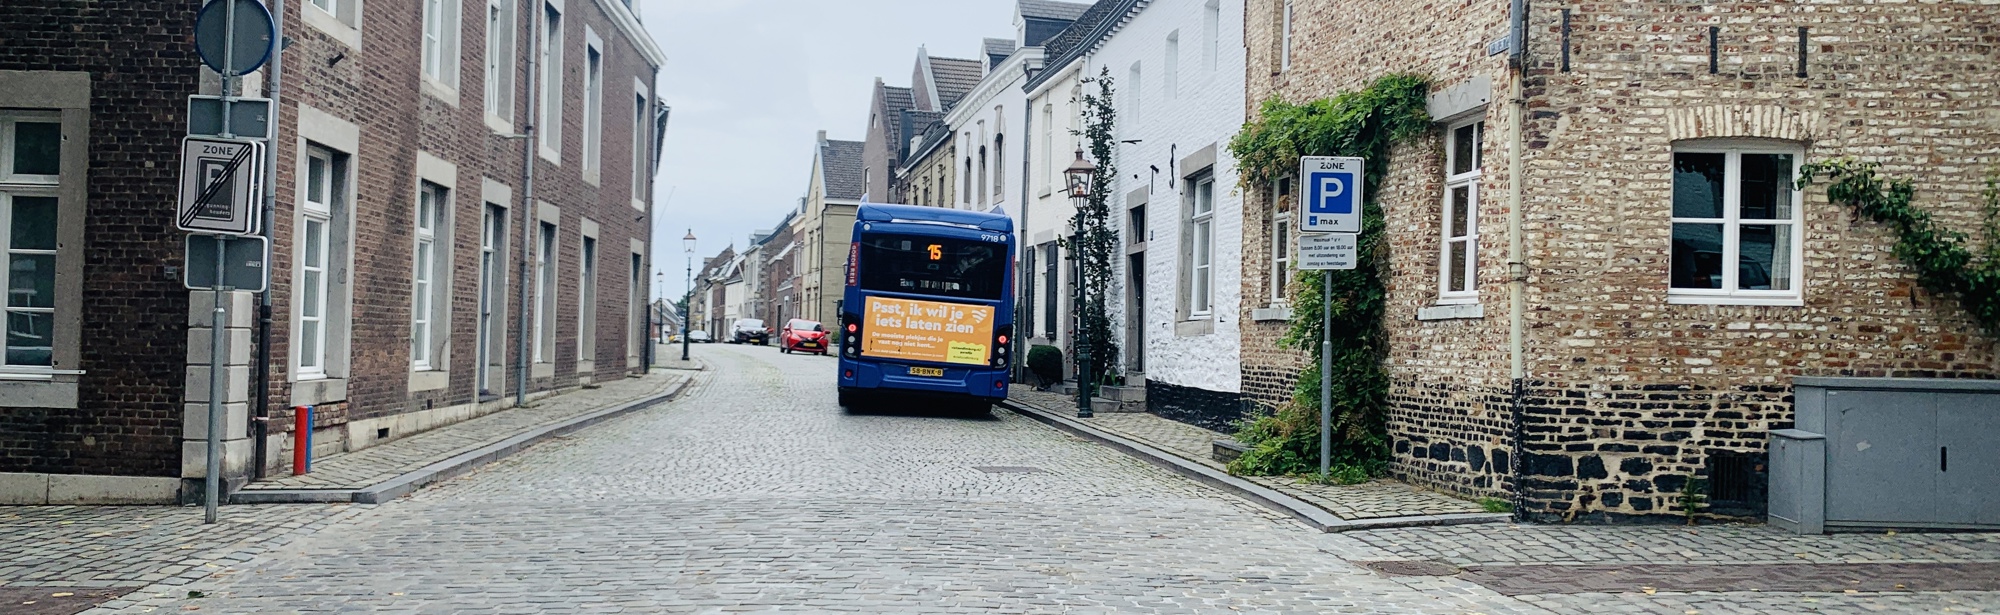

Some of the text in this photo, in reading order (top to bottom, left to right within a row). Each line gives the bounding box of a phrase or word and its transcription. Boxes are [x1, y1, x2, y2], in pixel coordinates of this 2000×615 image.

[203, 145, 233, 155] ZONE
[1320, 162, 1345, 170] ZONE
[1320, 177, 1344, 209] P
[981, 234, 999, 242] 9718
[927, 244, 942, 260] 15
[872, 302, 963, 321] Psst, ik wil je
[876, 314, 974, 333] iets laten zien
